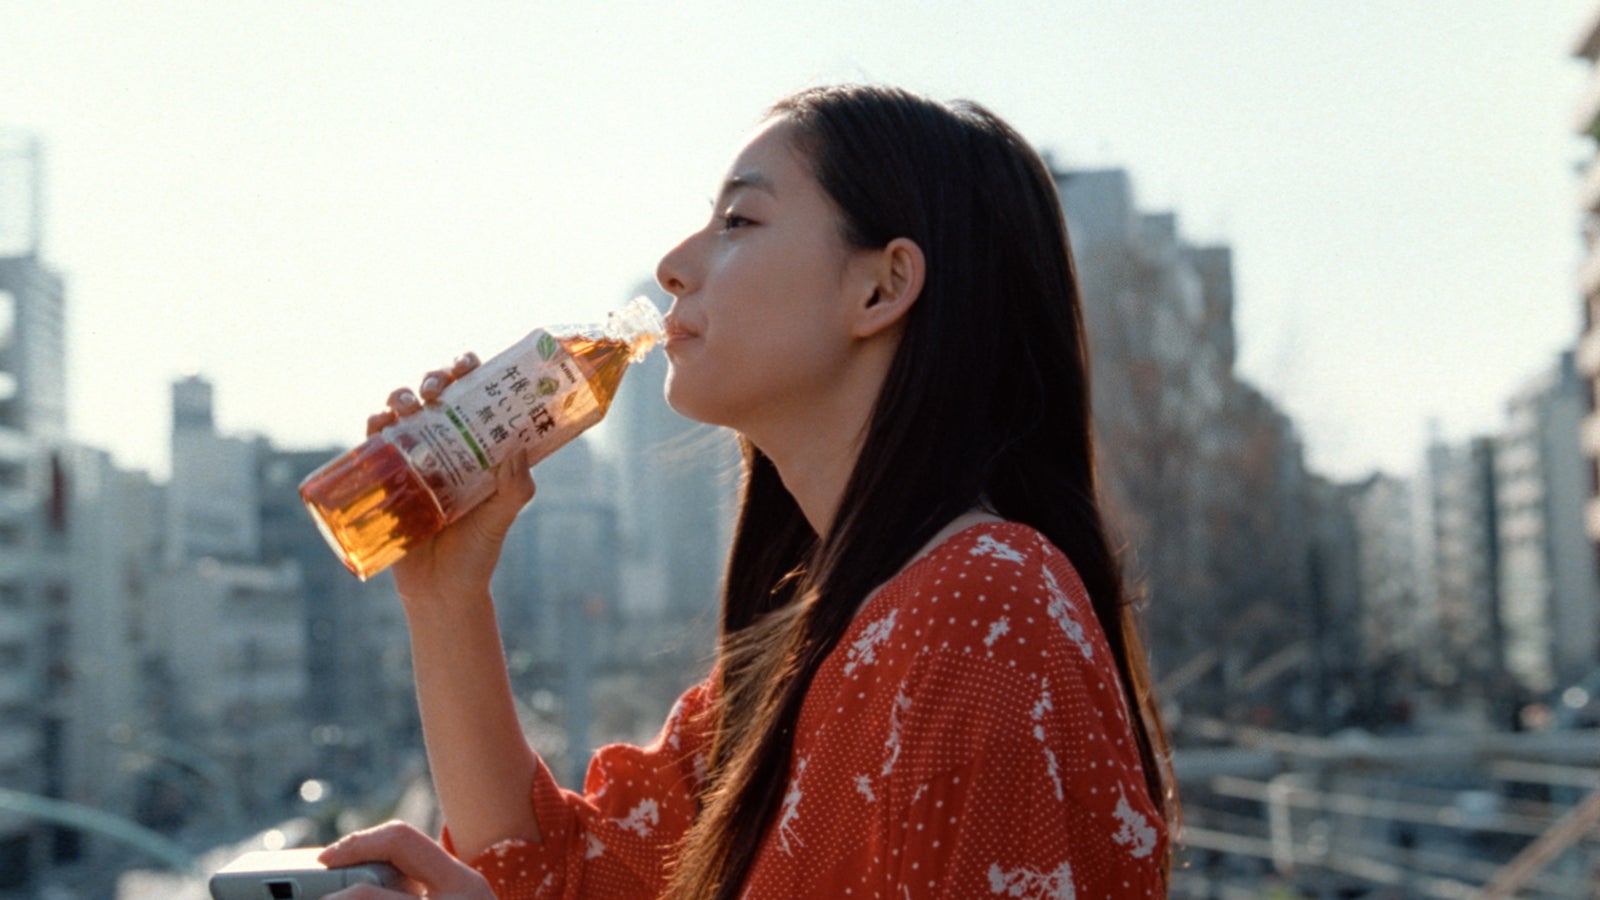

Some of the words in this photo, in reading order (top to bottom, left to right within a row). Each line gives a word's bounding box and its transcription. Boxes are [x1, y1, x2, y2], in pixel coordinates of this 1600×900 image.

[485, 382, 531, 442] おいしい
[501, 366, 555, 438] 午後の紅茶
